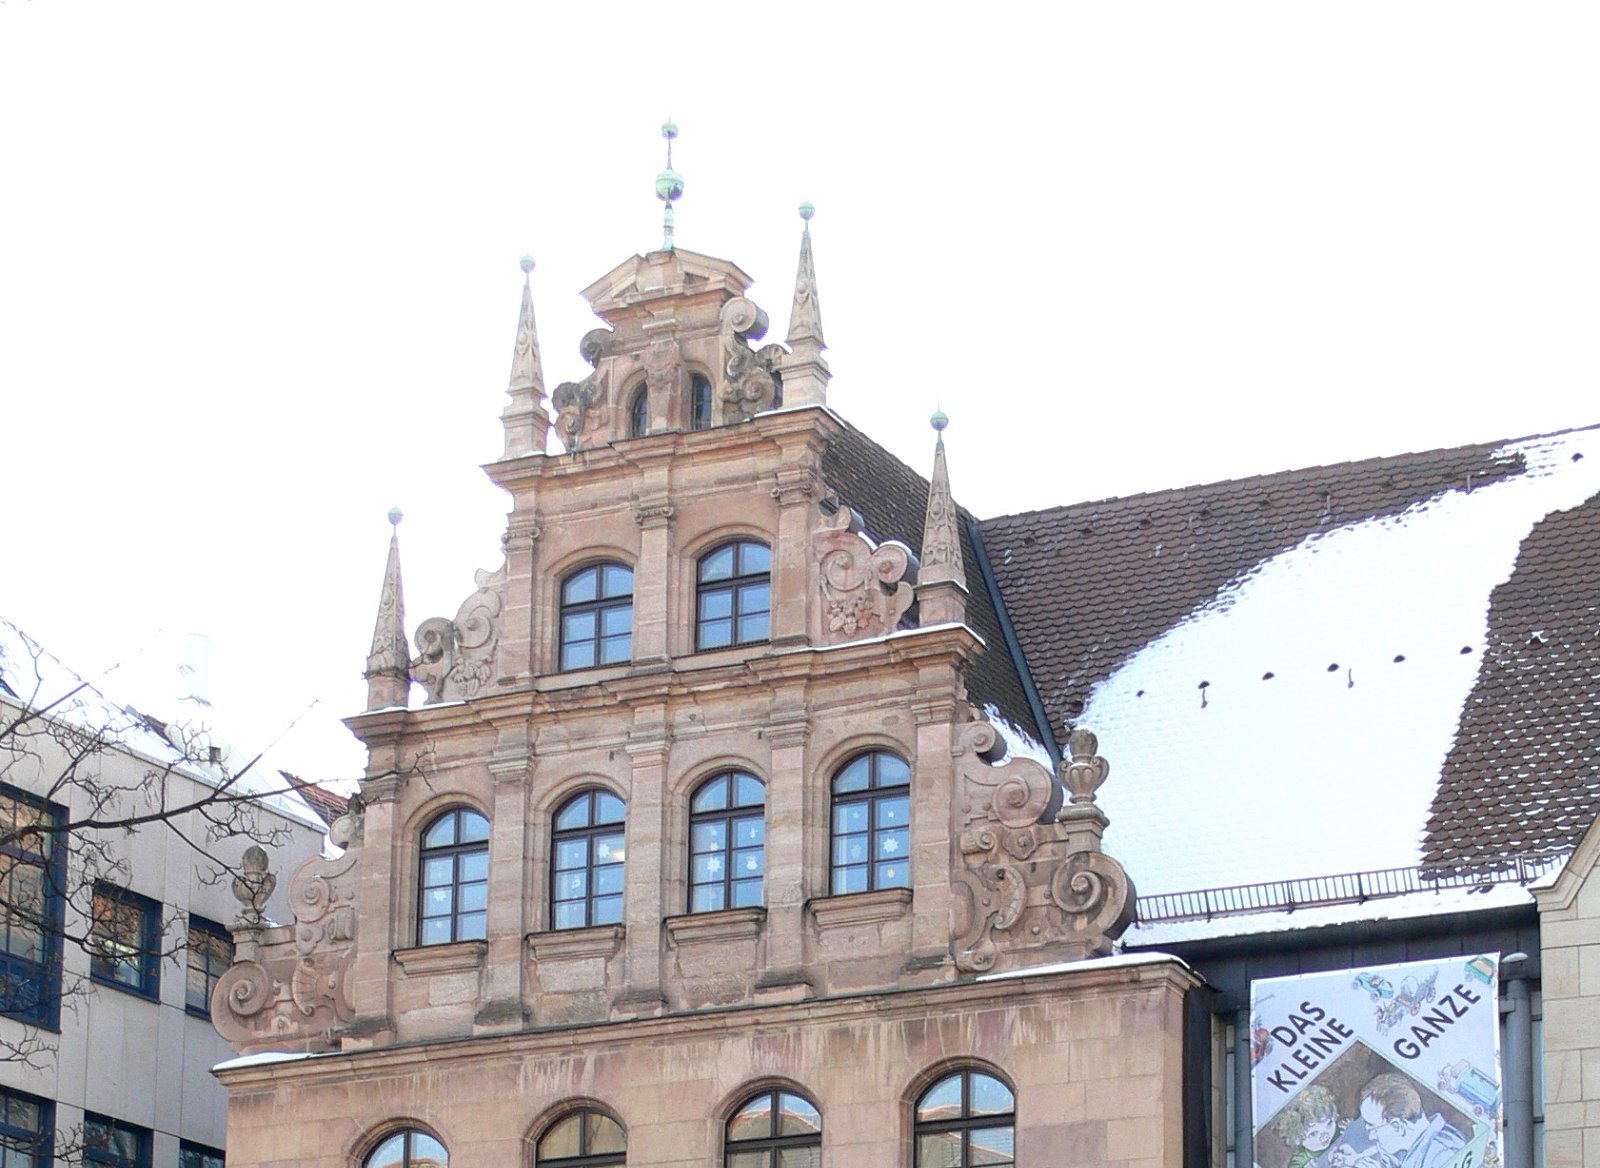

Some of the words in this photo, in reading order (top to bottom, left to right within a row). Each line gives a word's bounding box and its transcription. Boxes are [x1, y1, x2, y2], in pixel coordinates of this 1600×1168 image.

[1266, 1017, 1354, 1093] KLEINE
[1270, 1001, 1326, 1047] DAS
[1393, 984, 1481, 1060] GANZE
